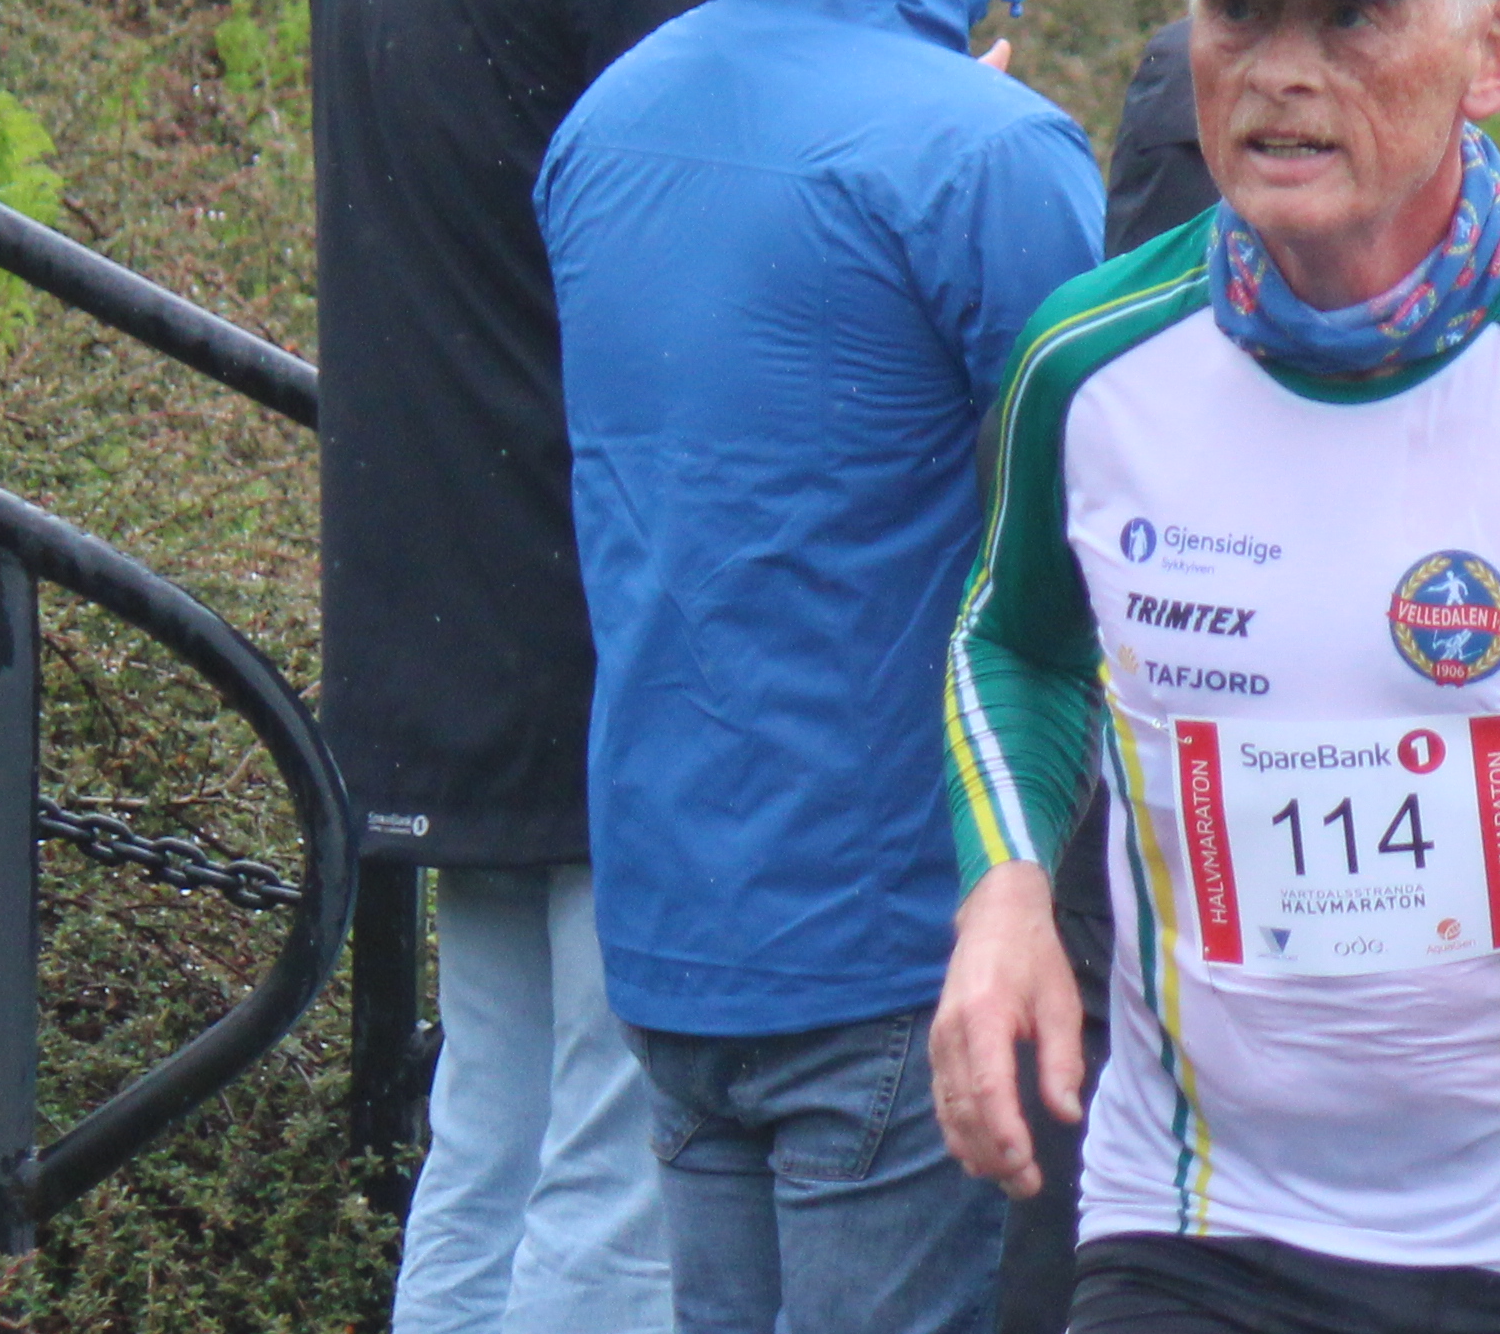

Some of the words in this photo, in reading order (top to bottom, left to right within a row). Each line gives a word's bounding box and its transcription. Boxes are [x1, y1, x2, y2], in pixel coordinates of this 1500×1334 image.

[1163, 525, 1282, 564] Gjensidige
[1126, 591, 1256, 638] TRIMTEX
[1398, 600, 1488, 627] VELLEDALEN
[1144, 660, 1270, 695] TAFJORD
[1436, 665, 1465, 678] 1906
[1241, 742, 1392, 774] SpareBank
[1410, 736, 1431, 767] 1
[1191, 759, 1229, 924] HALVMARATON
[1272, 793, 1435, 876] 114
[1280, 884, 1425, 899] VARTDALSSTRANDA
[1281, 893, 1426, 915] HALVMARATON
